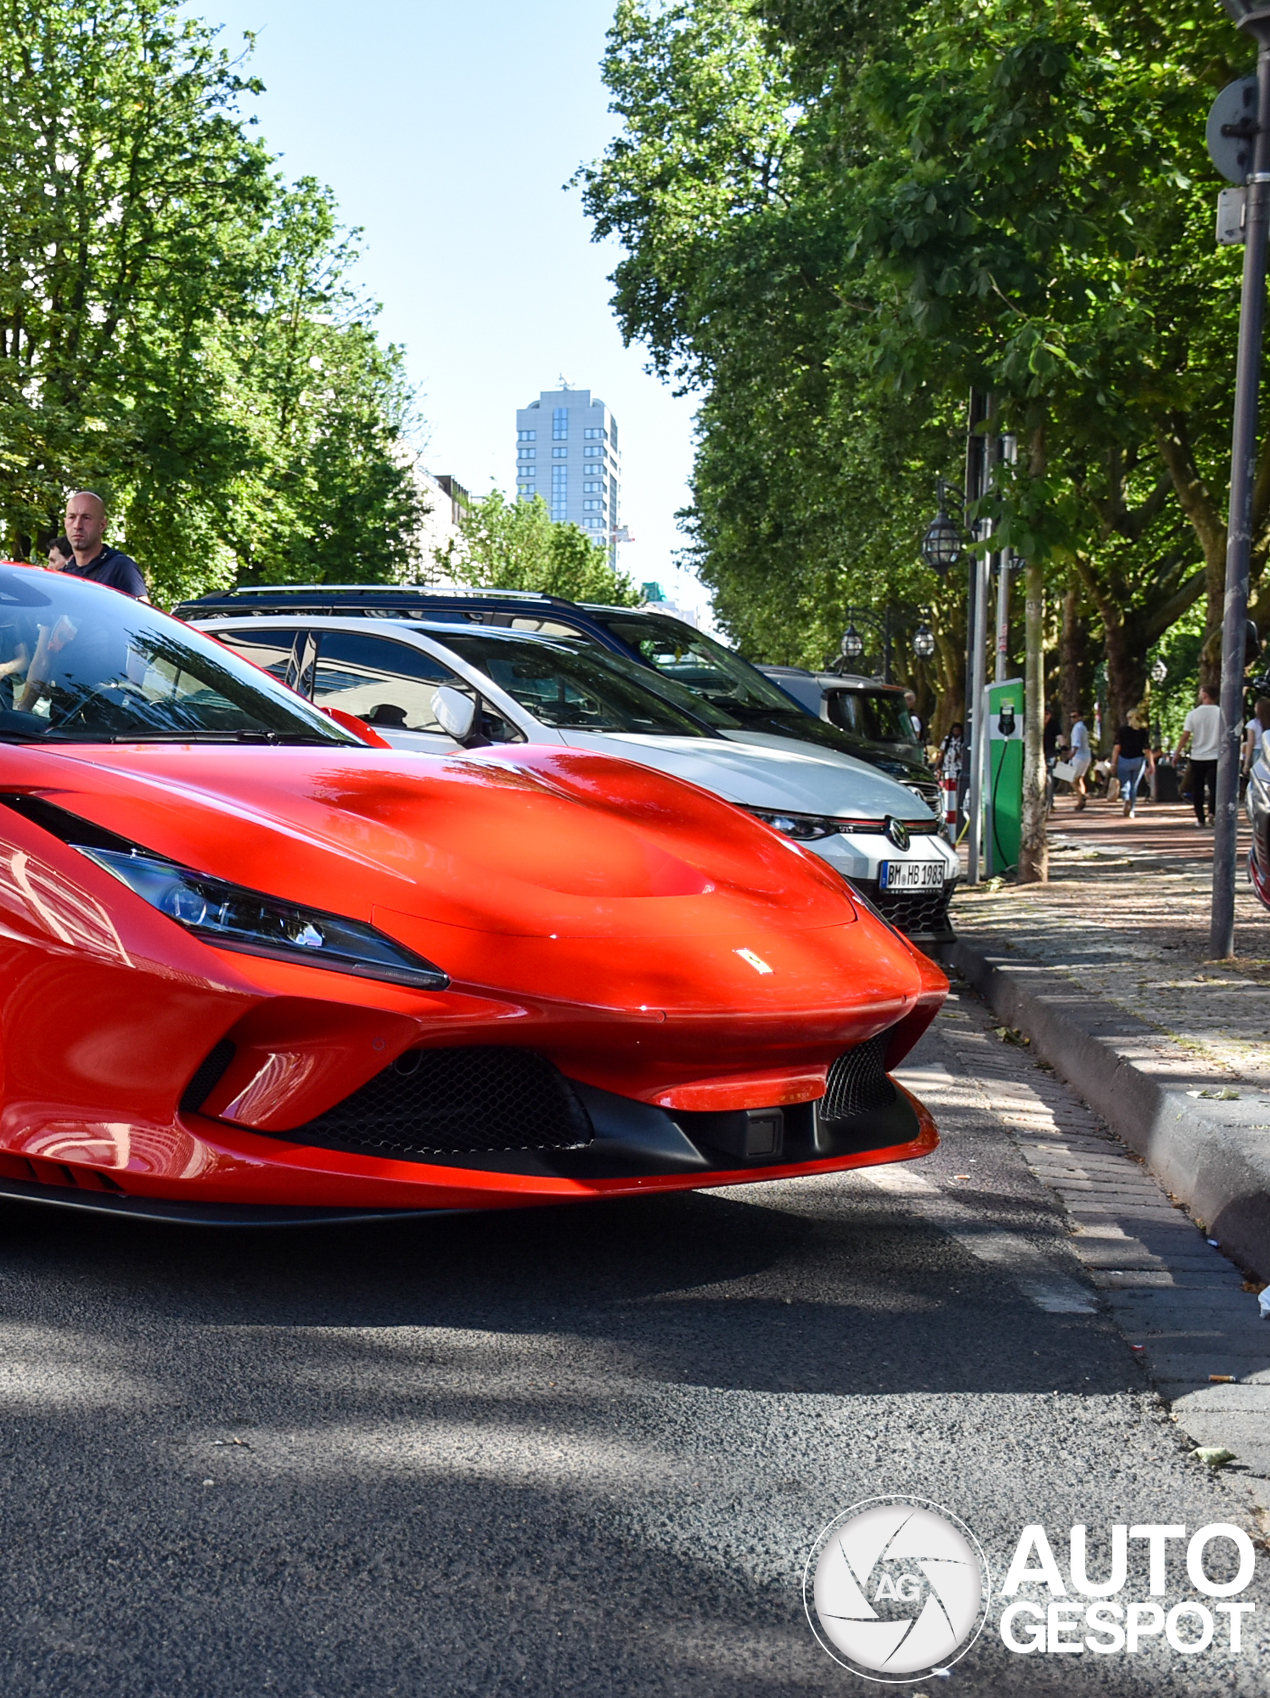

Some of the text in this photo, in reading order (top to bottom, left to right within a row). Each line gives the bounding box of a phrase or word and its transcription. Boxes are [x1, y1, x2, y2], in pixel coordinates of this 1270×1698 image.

[888, 864, 943, 885] BM HB 1983
